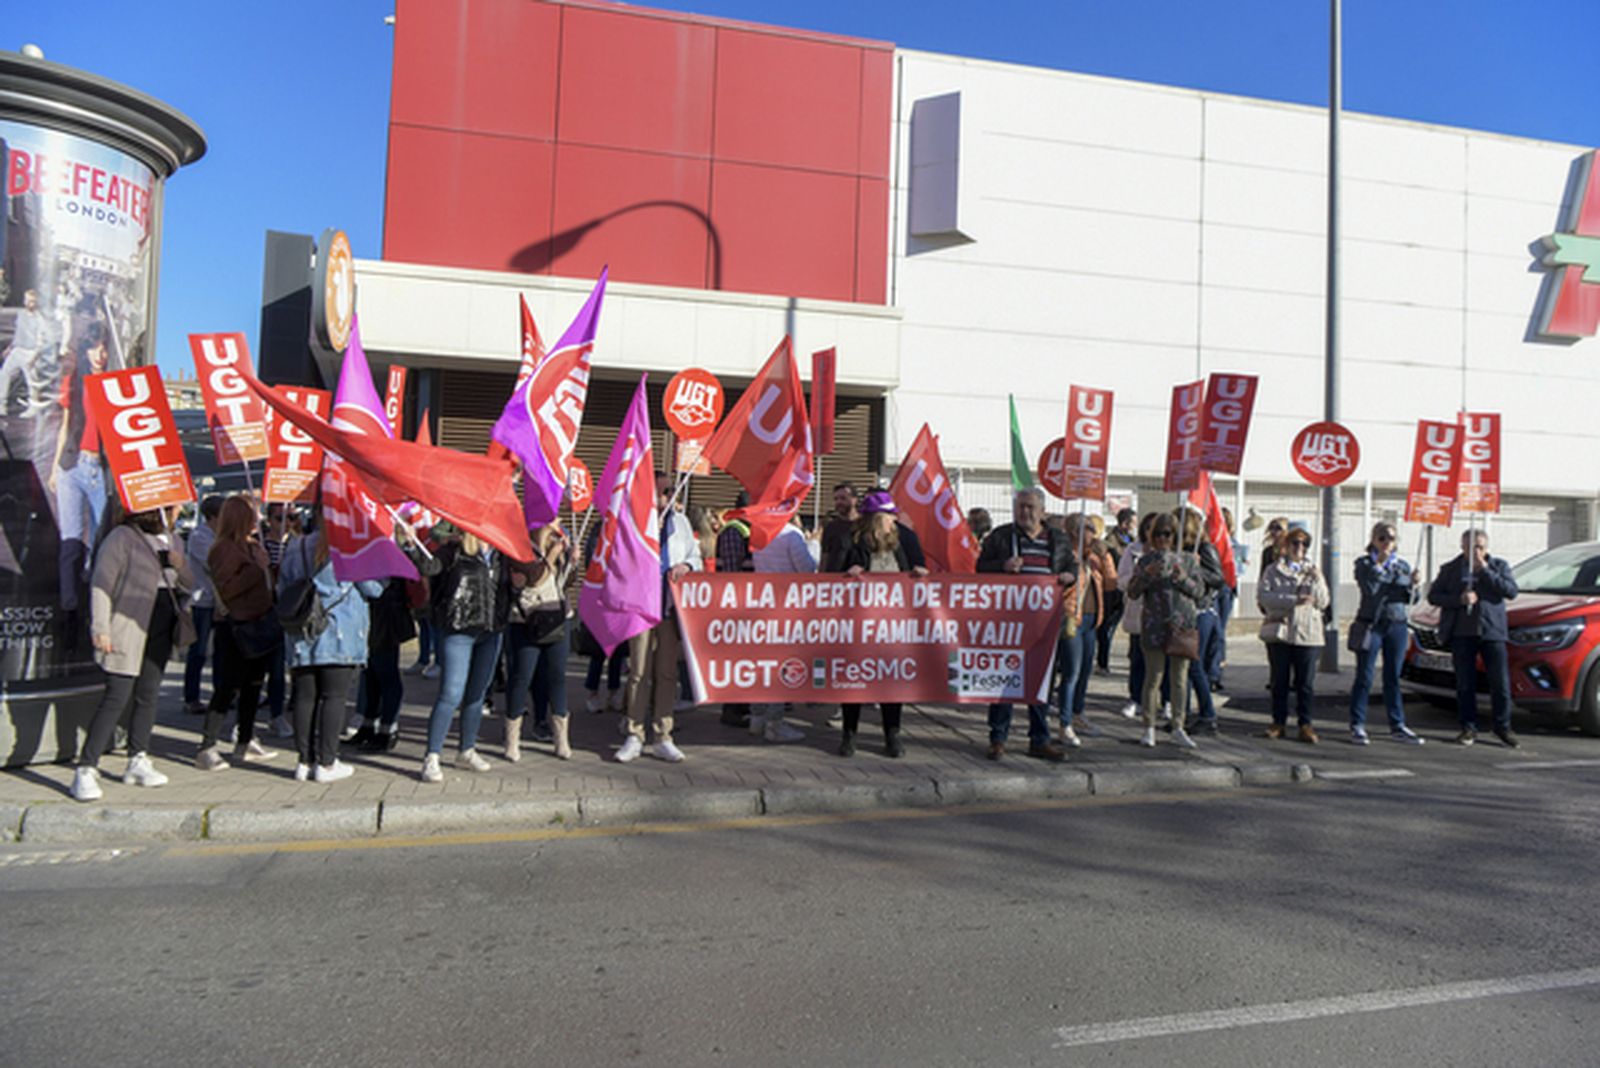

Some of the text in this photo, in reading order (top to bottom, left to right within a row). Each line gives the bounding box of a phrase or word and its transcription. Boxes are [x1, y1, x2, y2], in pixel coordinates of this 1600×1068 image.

[56, 198, 128, 227] LONDON
[201, 338, 251, 426] UGT
[387, 371, 401, 428] UG
[673, 378, 718, 412] UGT
[102, 373, 167, 472] UGT
[1072, 391, 1104, 468] UGT
[1176, 386, 1200, 461] UGT
[1209, 378, 1249, 446] UGT
[1302, 432, 1350, 459] UGT
[1420, 426, 1456, 497] UGT
[1462, 416, 1491, 485] UGT
[905, 459, 970, 549] UG
[681, 582, 1054, 611] NO A LA APERTURA DE FESTIVOS
[0, 622, 45, 636] LOW
[707, 619, 853, 644] CONCILIACION
[861, 619, 958, 644] FAMILIAR
[708, 657, 917, 689] UGT FeSMC
[961, 652, 1003, 671] UGT
[972, 674, 1021, 689] FeSMC
